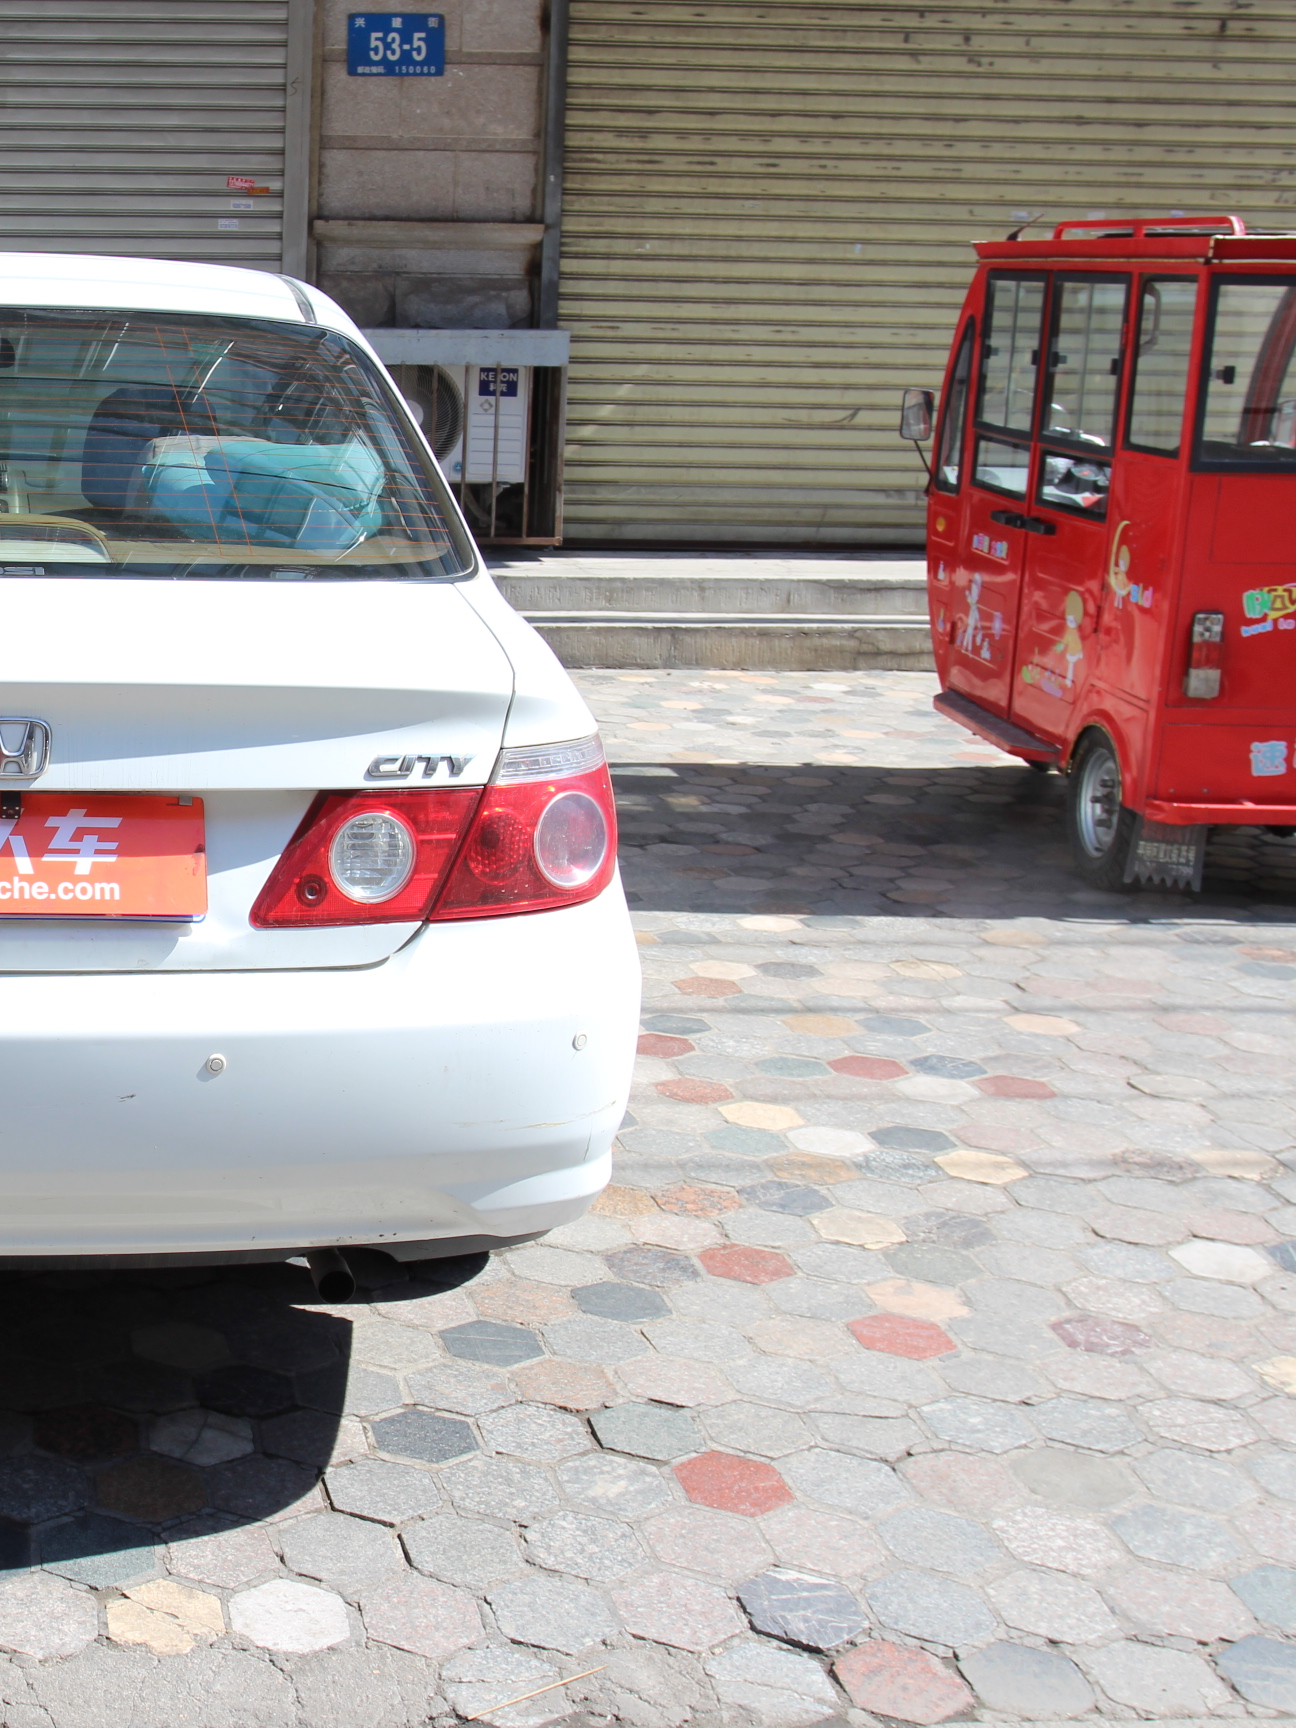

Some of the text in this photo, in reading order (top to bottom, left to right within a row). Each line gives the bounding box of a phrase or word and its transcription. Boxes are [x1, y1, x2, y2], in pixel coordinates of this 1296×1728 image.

[369, 32, 427, 61] 53-5
[395, 66, 436, 74] 150060
[480, 372, 518, 382] KEON
[367, 753, 478, 778] CITY
[1249, 740, 1296, 777] 速
